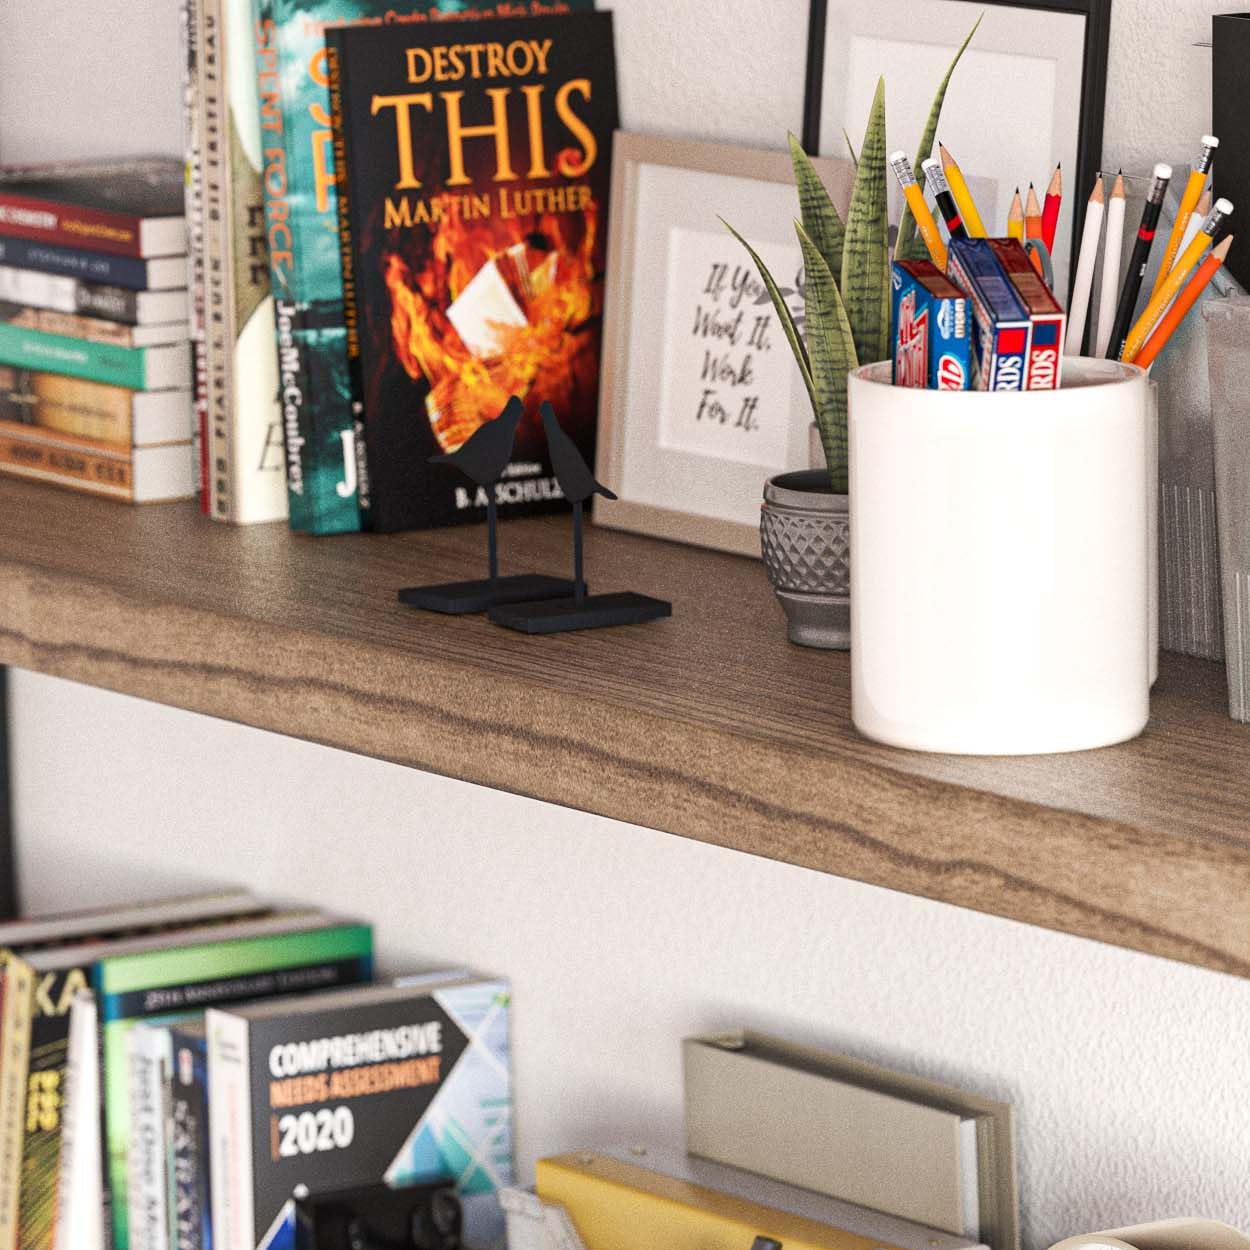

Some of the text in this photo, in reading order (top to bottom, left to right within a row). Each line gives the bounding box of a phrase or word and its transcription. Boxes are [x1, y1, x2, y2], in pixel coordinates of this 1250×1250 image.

[405, 38, 552, 84] DESTROY
[370, 78, 598, 190] THIS
[263, 148, 294, 272] FORCE
[383, 185, 595, 229] MARTIN LUTHER
[268, 1020, 443, 1078] COMPREHENSIVE
[279, 1106, 354, 1157] 2020
